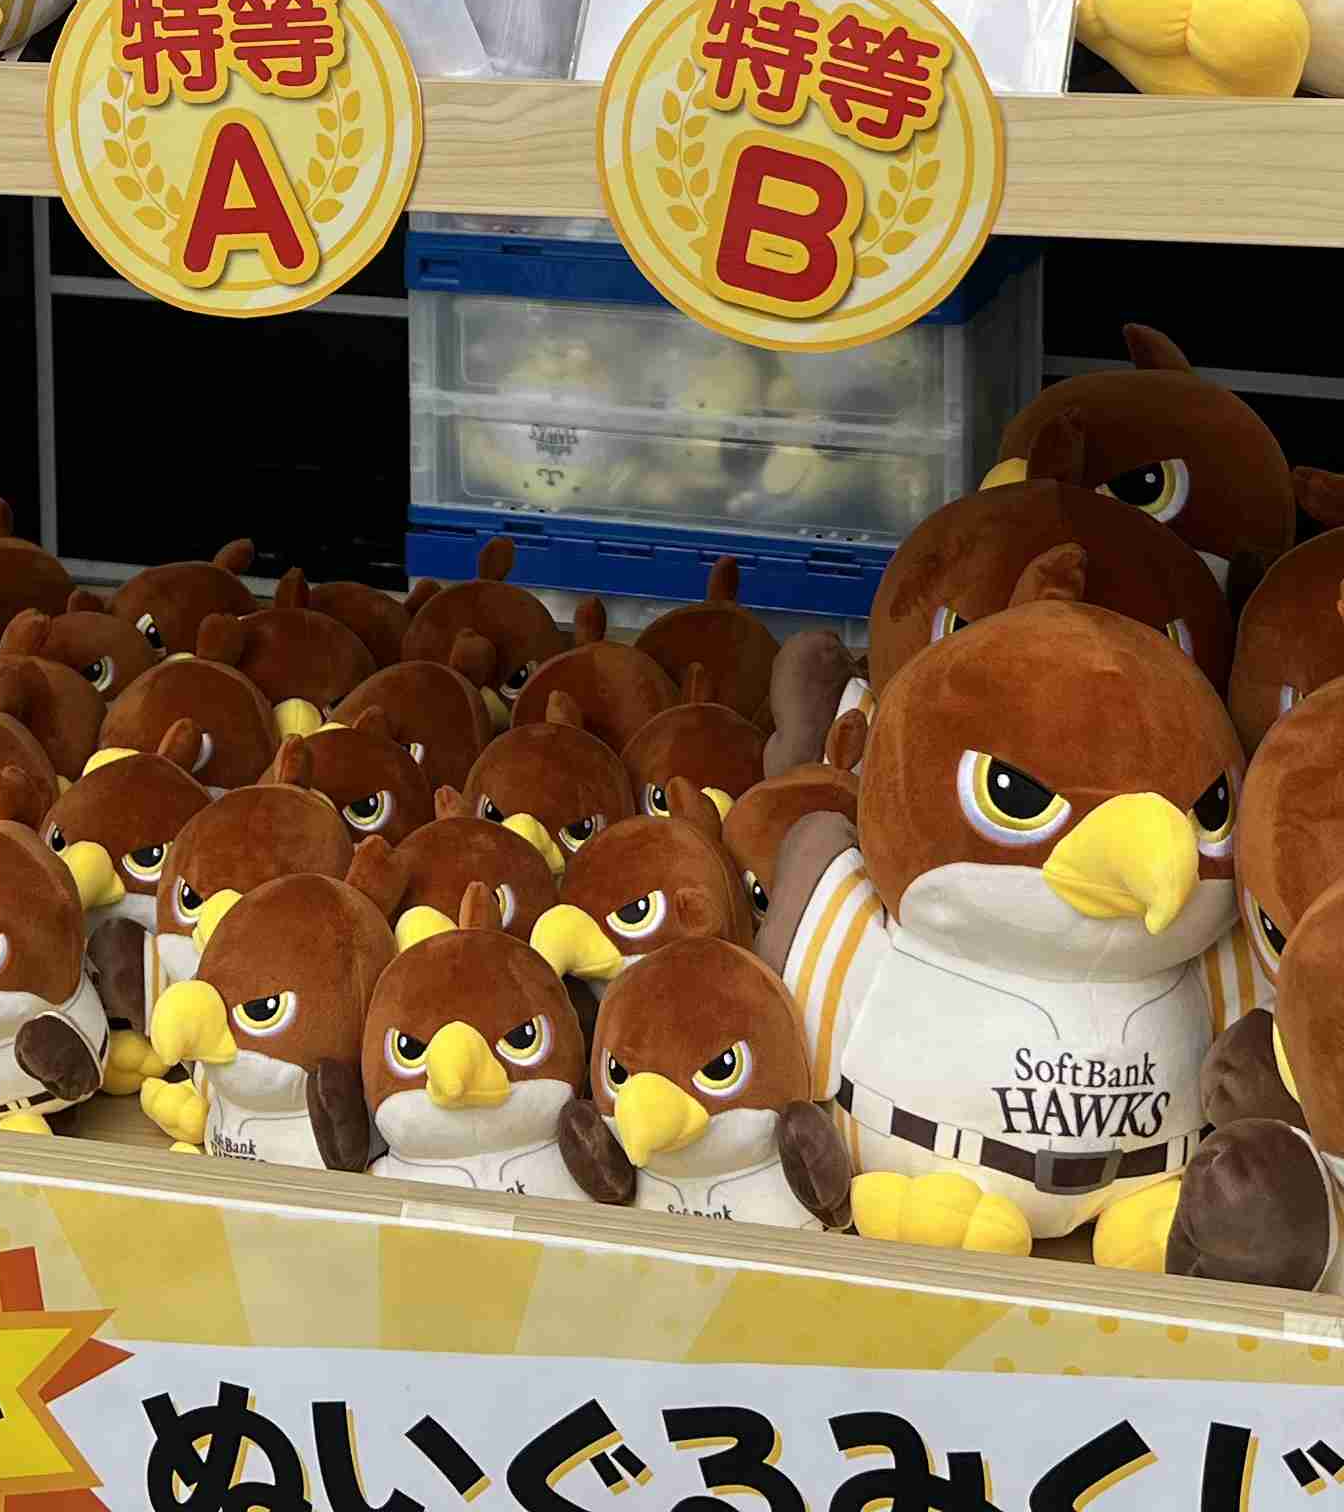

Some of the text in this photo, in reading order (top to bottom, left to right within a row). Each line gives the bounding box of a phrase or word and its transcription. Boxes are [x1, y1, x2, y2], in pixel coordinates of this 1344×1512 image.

[183, 121, 305, 273] A
[716, 144, 849, 302] B
[991, 1086, 1171, 1139] HAWKS
[1013, 1047, 1157, 1089] SoftBank
